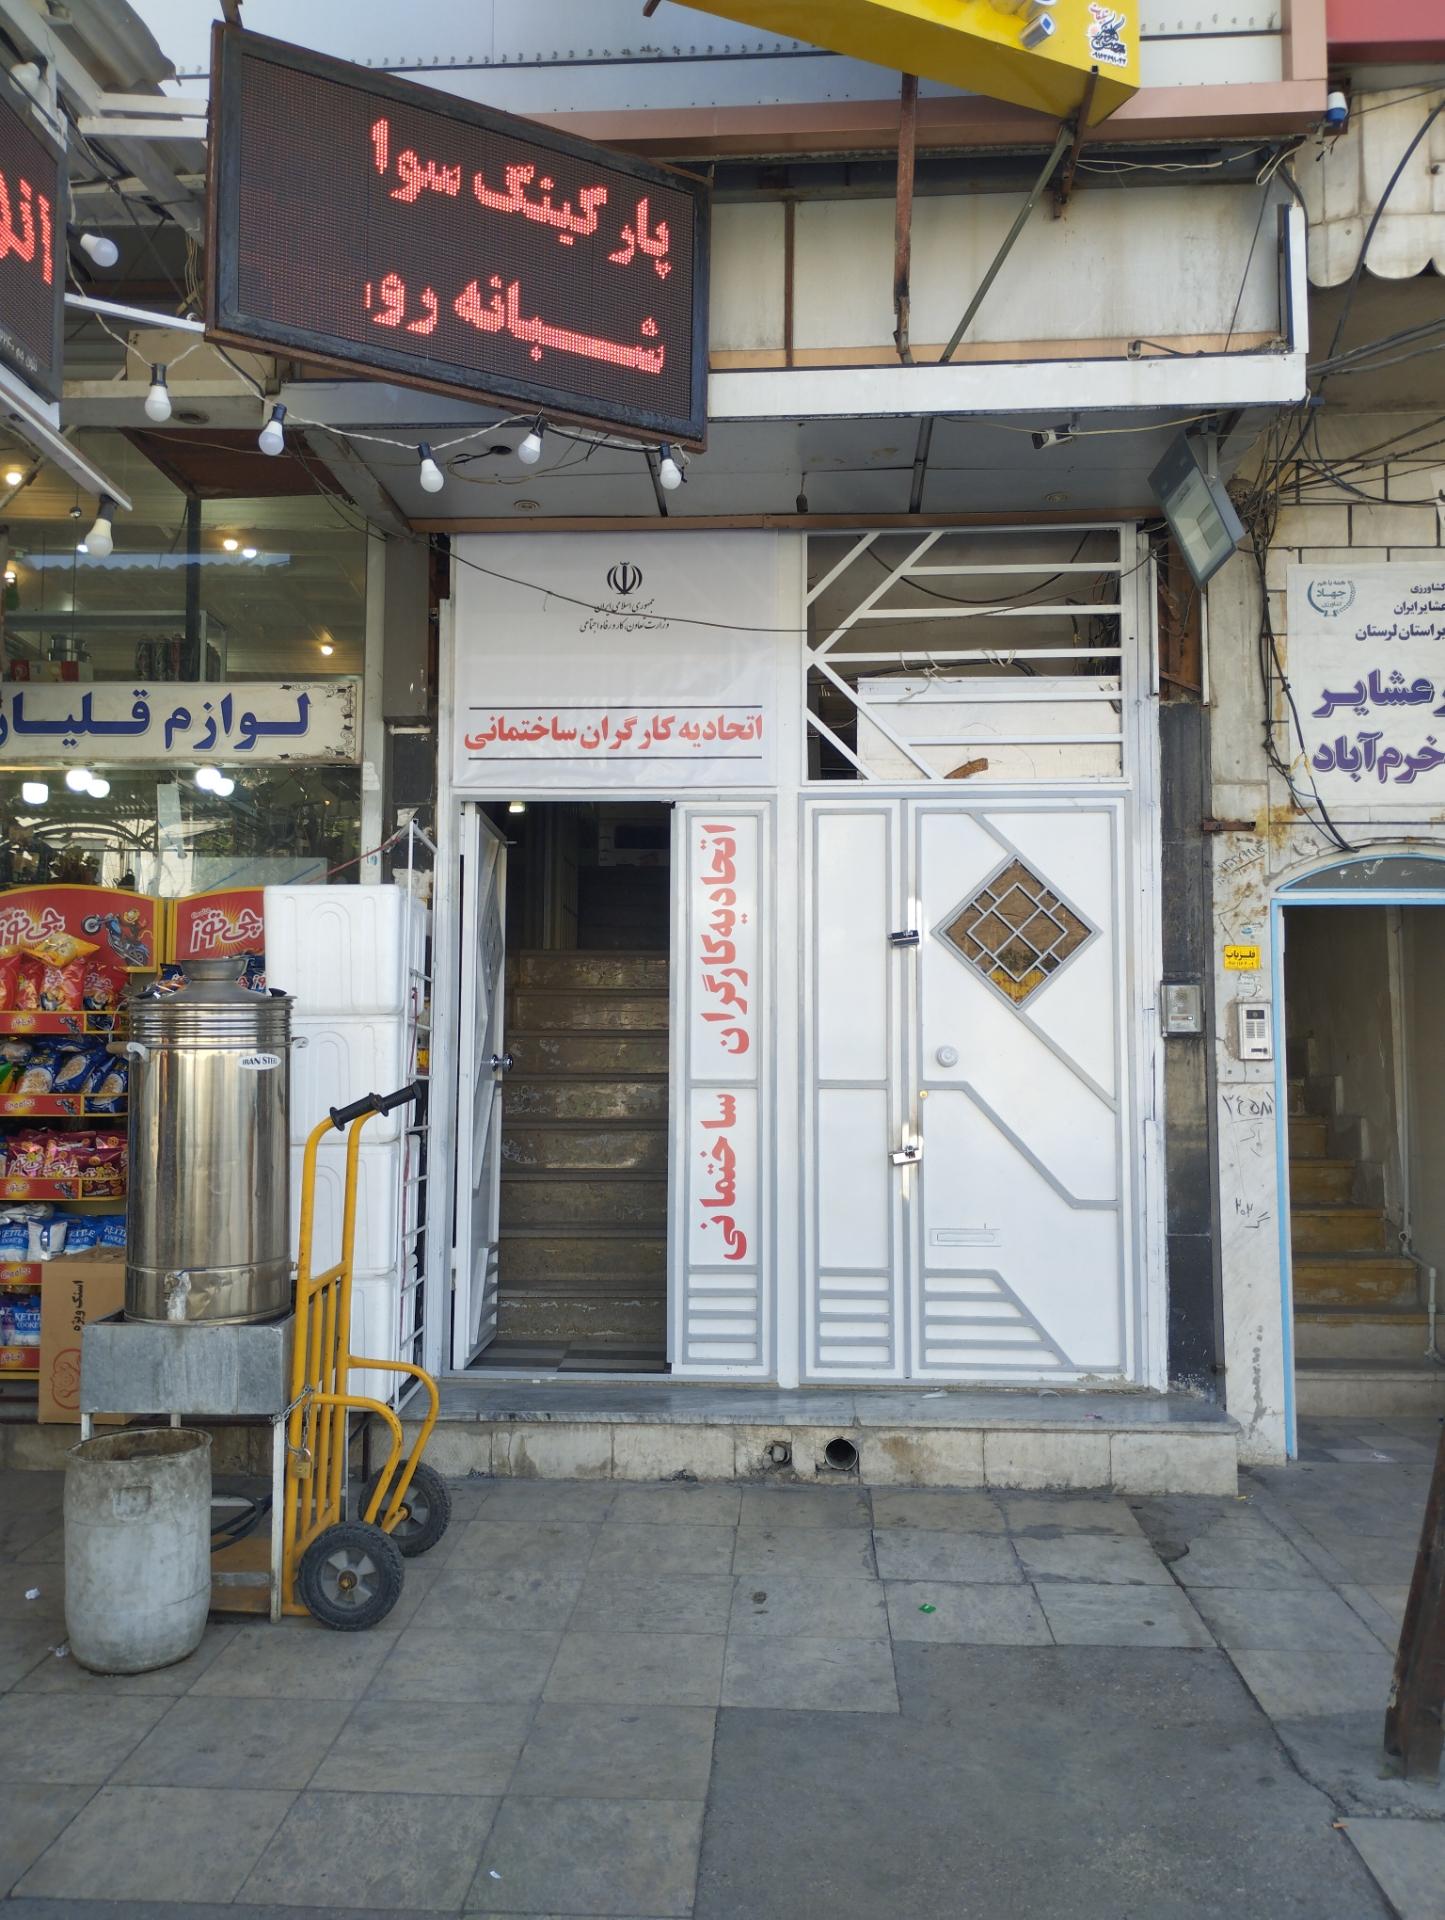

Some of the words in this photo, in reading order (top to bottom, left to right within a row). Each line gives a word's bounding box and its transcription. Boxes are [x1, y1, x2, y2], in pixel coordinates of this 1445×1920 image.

[454, 274, 663, 374] شبانه
[1393, 600, 1418, 616] ایران
[1355, 623, 1398, 641] لرستان
[1398, 623, 1435, 641] استان
[1311, 668, 1435, 719] عشایر
[163, 691, 312, 751] لوازم
[464, 714, 577, 751] ساختمانی
[579, 716, 675, 750] کارگران
[678, 714, 763, 748] اتحادیه
[700, 824, 748, 937] اتحادیه
[700, 934, 749, 1055] کارگران
[242, 1056, 261, 1066] IRAN
[699, 1093, 748, 1261] ساختمانی
